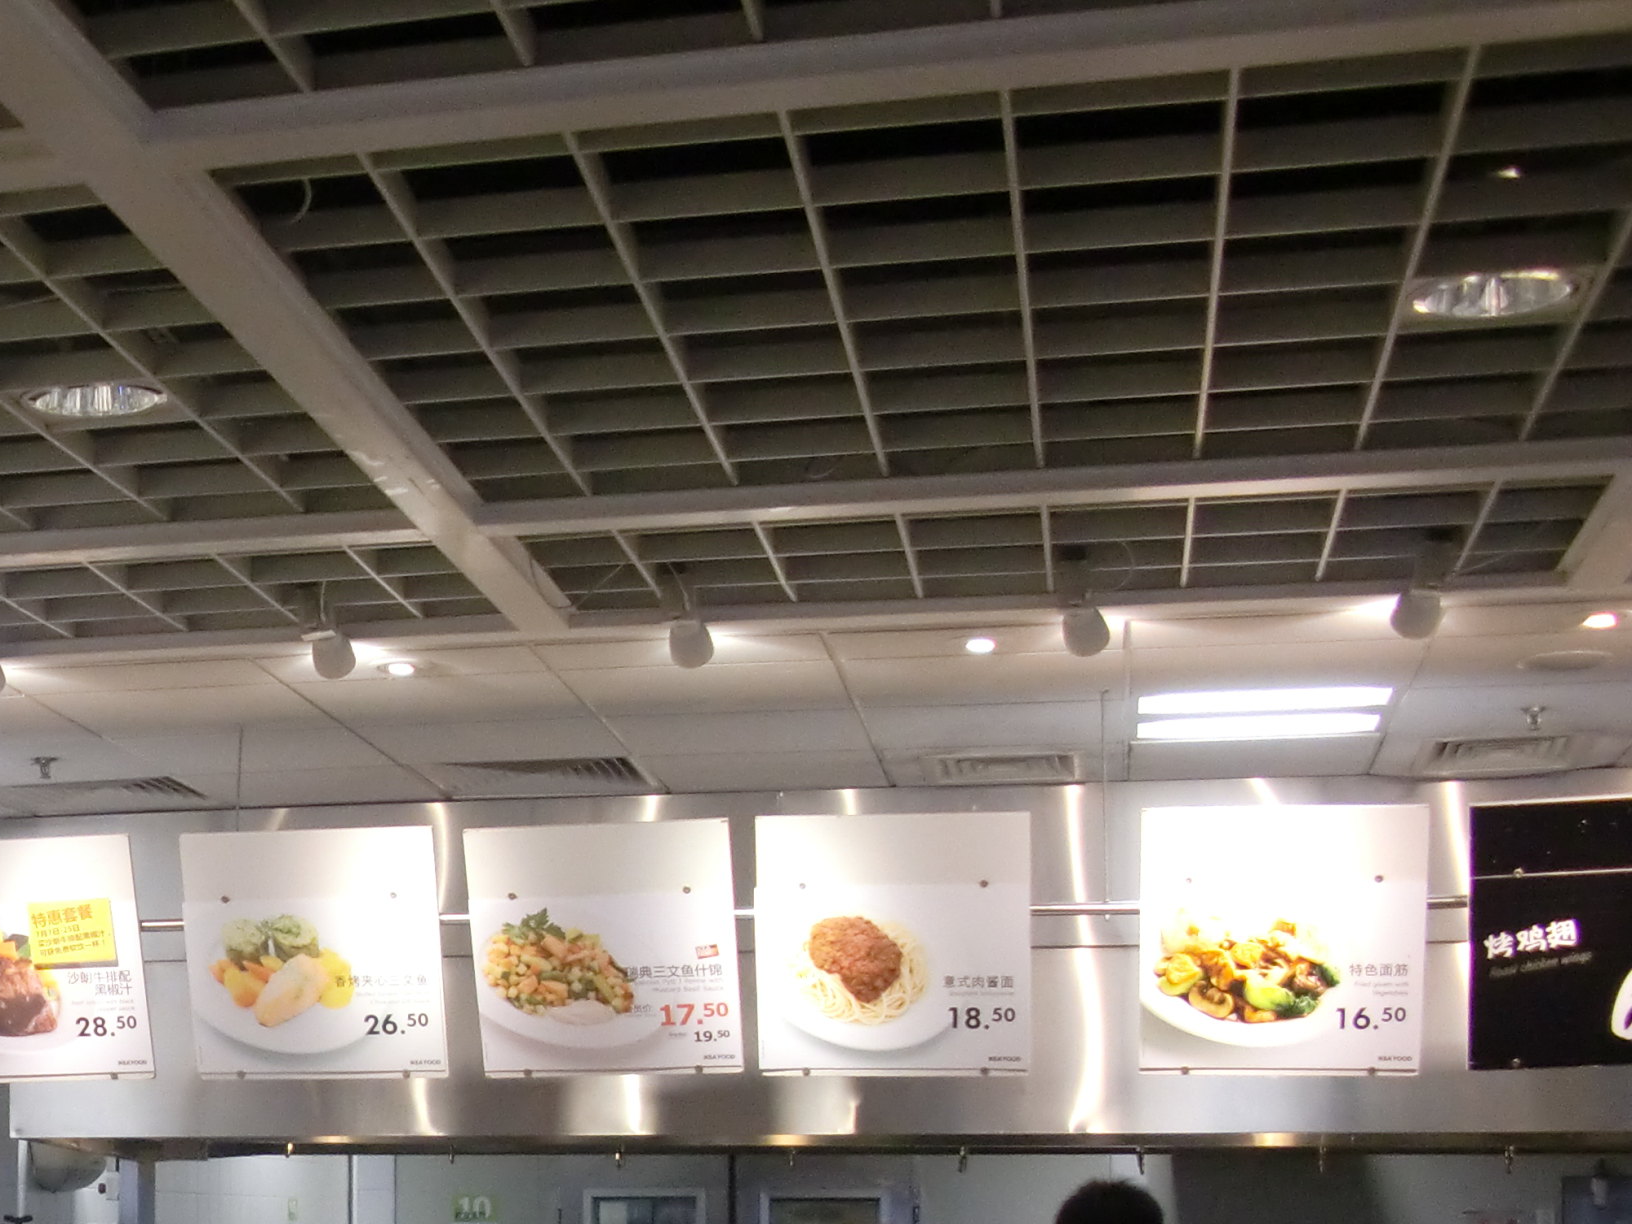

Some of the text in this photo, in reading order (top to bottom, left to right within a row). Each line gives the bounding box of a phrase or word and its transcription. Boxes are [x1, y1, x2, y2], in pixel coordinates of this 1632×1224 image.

[1483, 919, 1579, 960] 烤鸡翅
[1349, 963, 1408, 977] 特色面筋
[364, 1013, 429, 1036] 26.50
[660, 1002, 729, 1026] 17.50
[949, 1006, 1016, 1030] 18.50
[1336, 1006, 1407, 1030] 16.50
[75, 1015, 137, 1037] 28.50
[694, 1030, 730, 1042] 19.50
